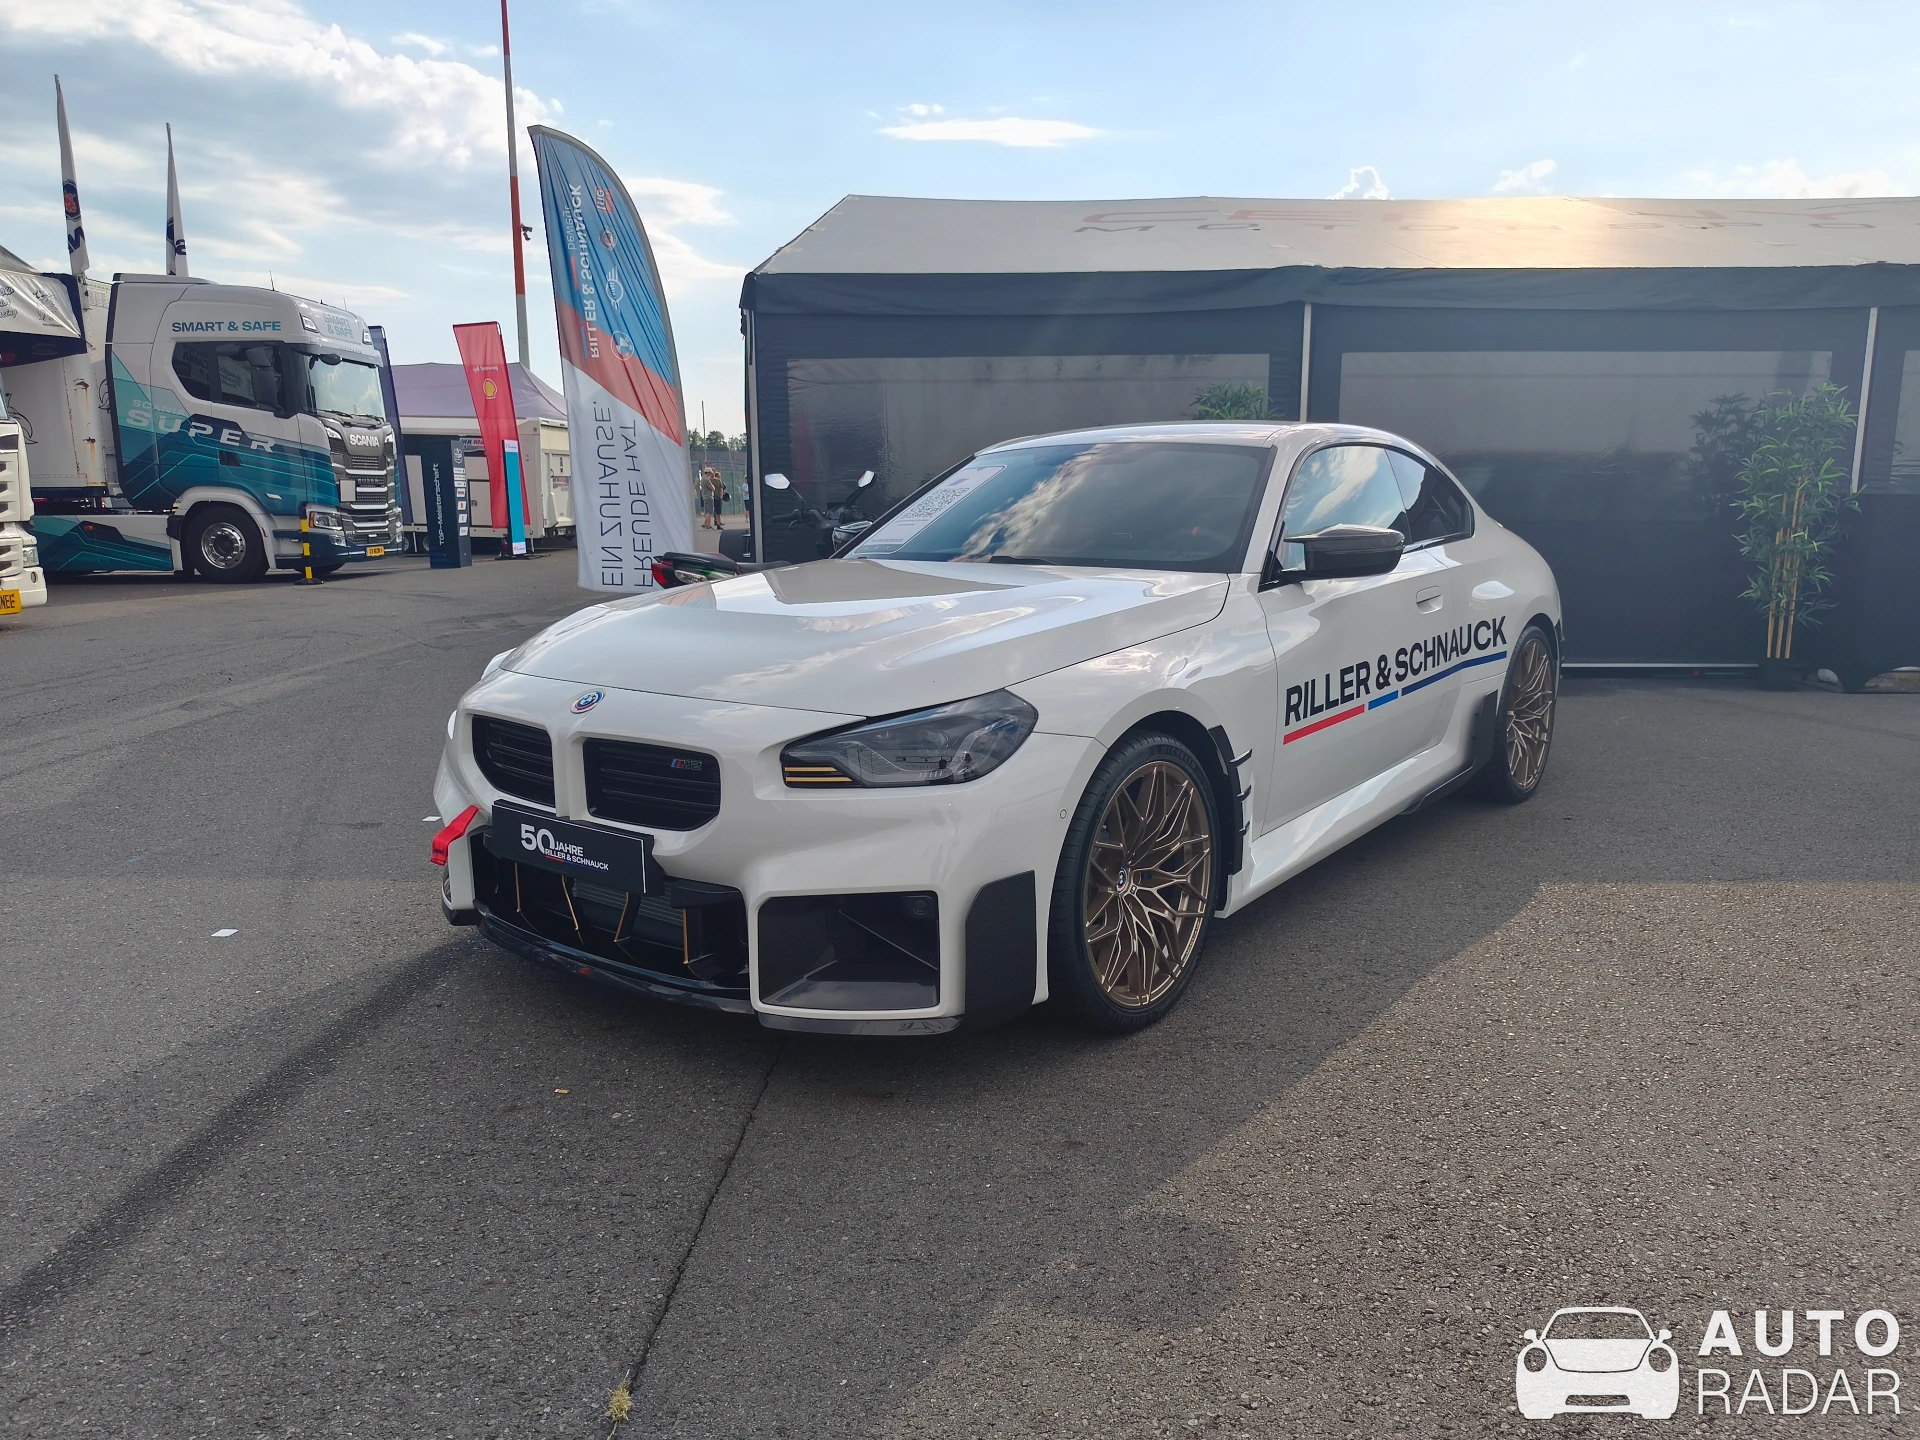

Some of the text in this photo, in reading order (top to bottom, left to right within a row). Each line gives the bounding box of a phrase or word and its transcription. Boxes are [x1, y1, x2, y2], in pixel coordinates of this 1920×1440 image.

[171, 321, 281, 332] SMART & SAFE
[323, 313, 351, 328] SMART
[327, 324, 354, 339] & SAFE
[132, 399, 186, 416] SCANIA
[126, 409, 276, 453] SUPER
[349, 434, 380, 447] SCANIA
[1284, 615, 1507, 727] RILLER & SCHNAUCK
[1159, 744, 1198, 770] MICHELIN
[521, 823, 583, 857] 50 JAHRE
[544, 848, 609, 871] RILLER & SCHNAUCK
